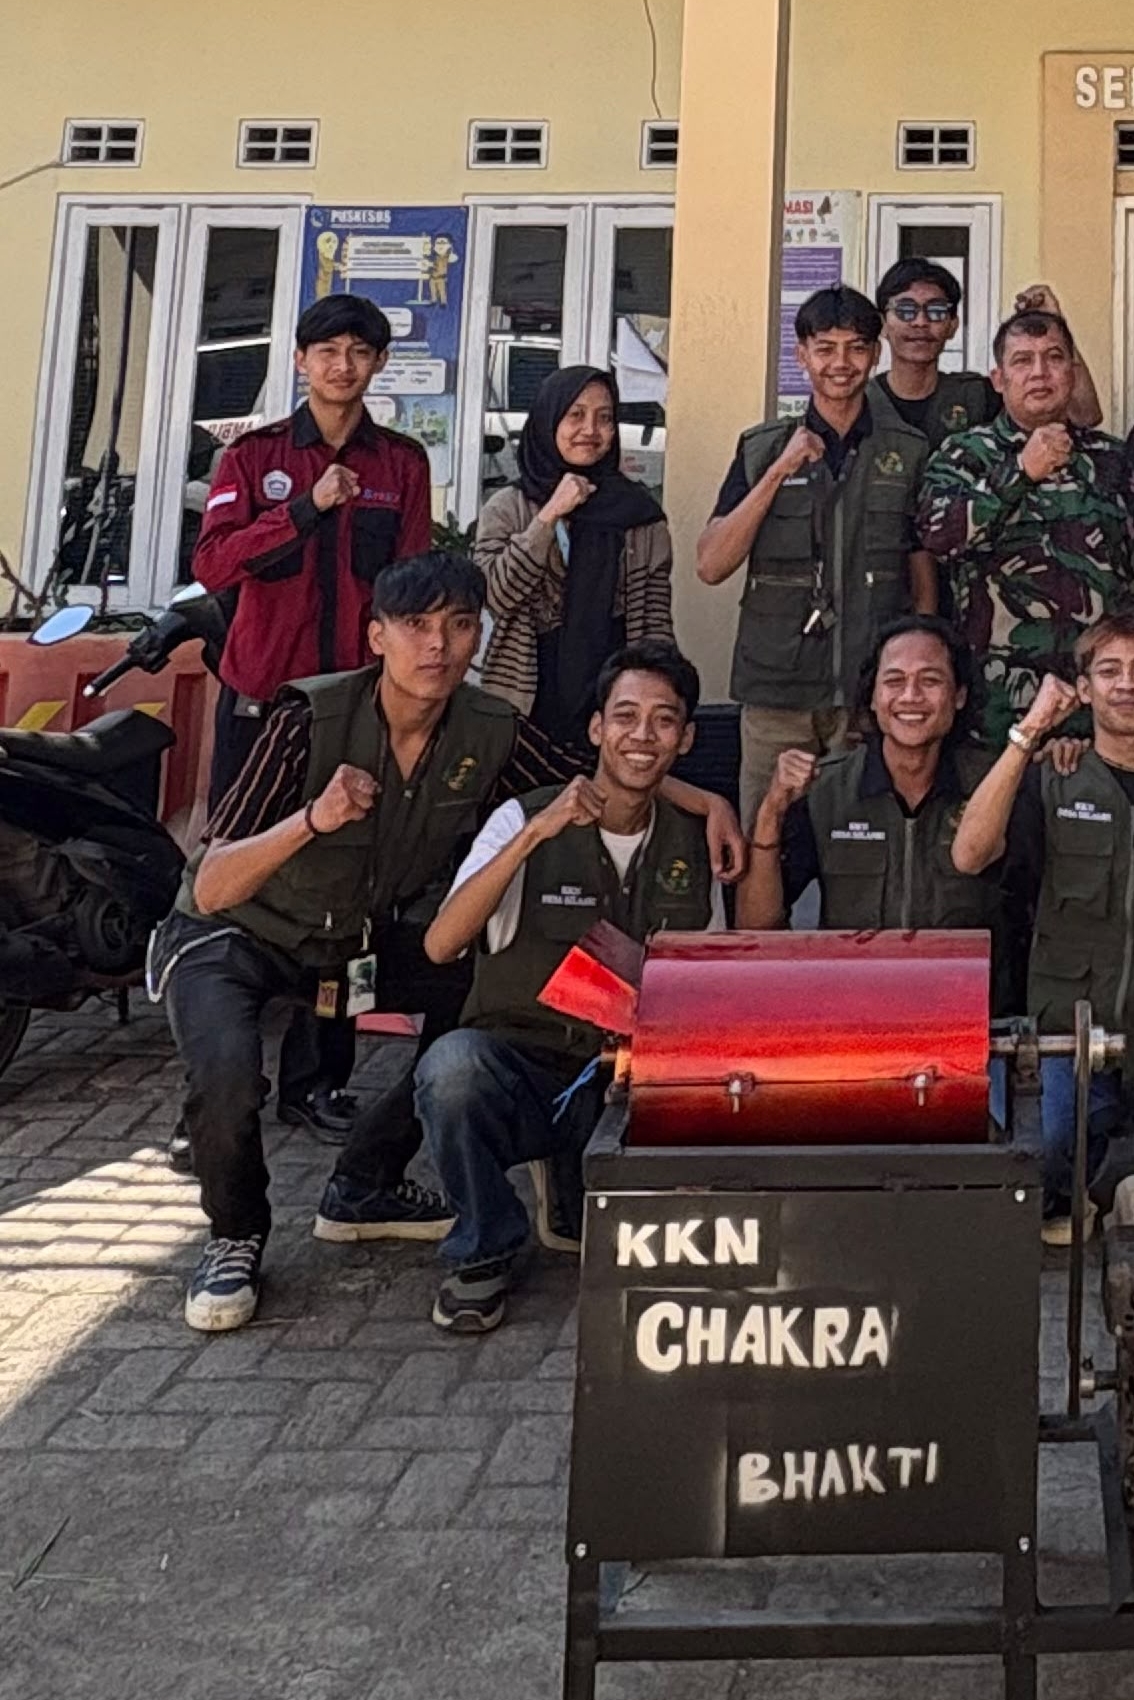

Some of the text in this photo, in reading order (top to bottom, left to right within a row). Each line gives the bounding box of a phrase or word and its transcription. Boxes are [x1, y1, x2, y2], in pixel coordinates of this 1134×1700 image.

[616, 1217, 760, 1268] KKN
[636, 1301, 890, 1373] CHAKRA
[738, 1442, 938, 1505] BHAKTI
